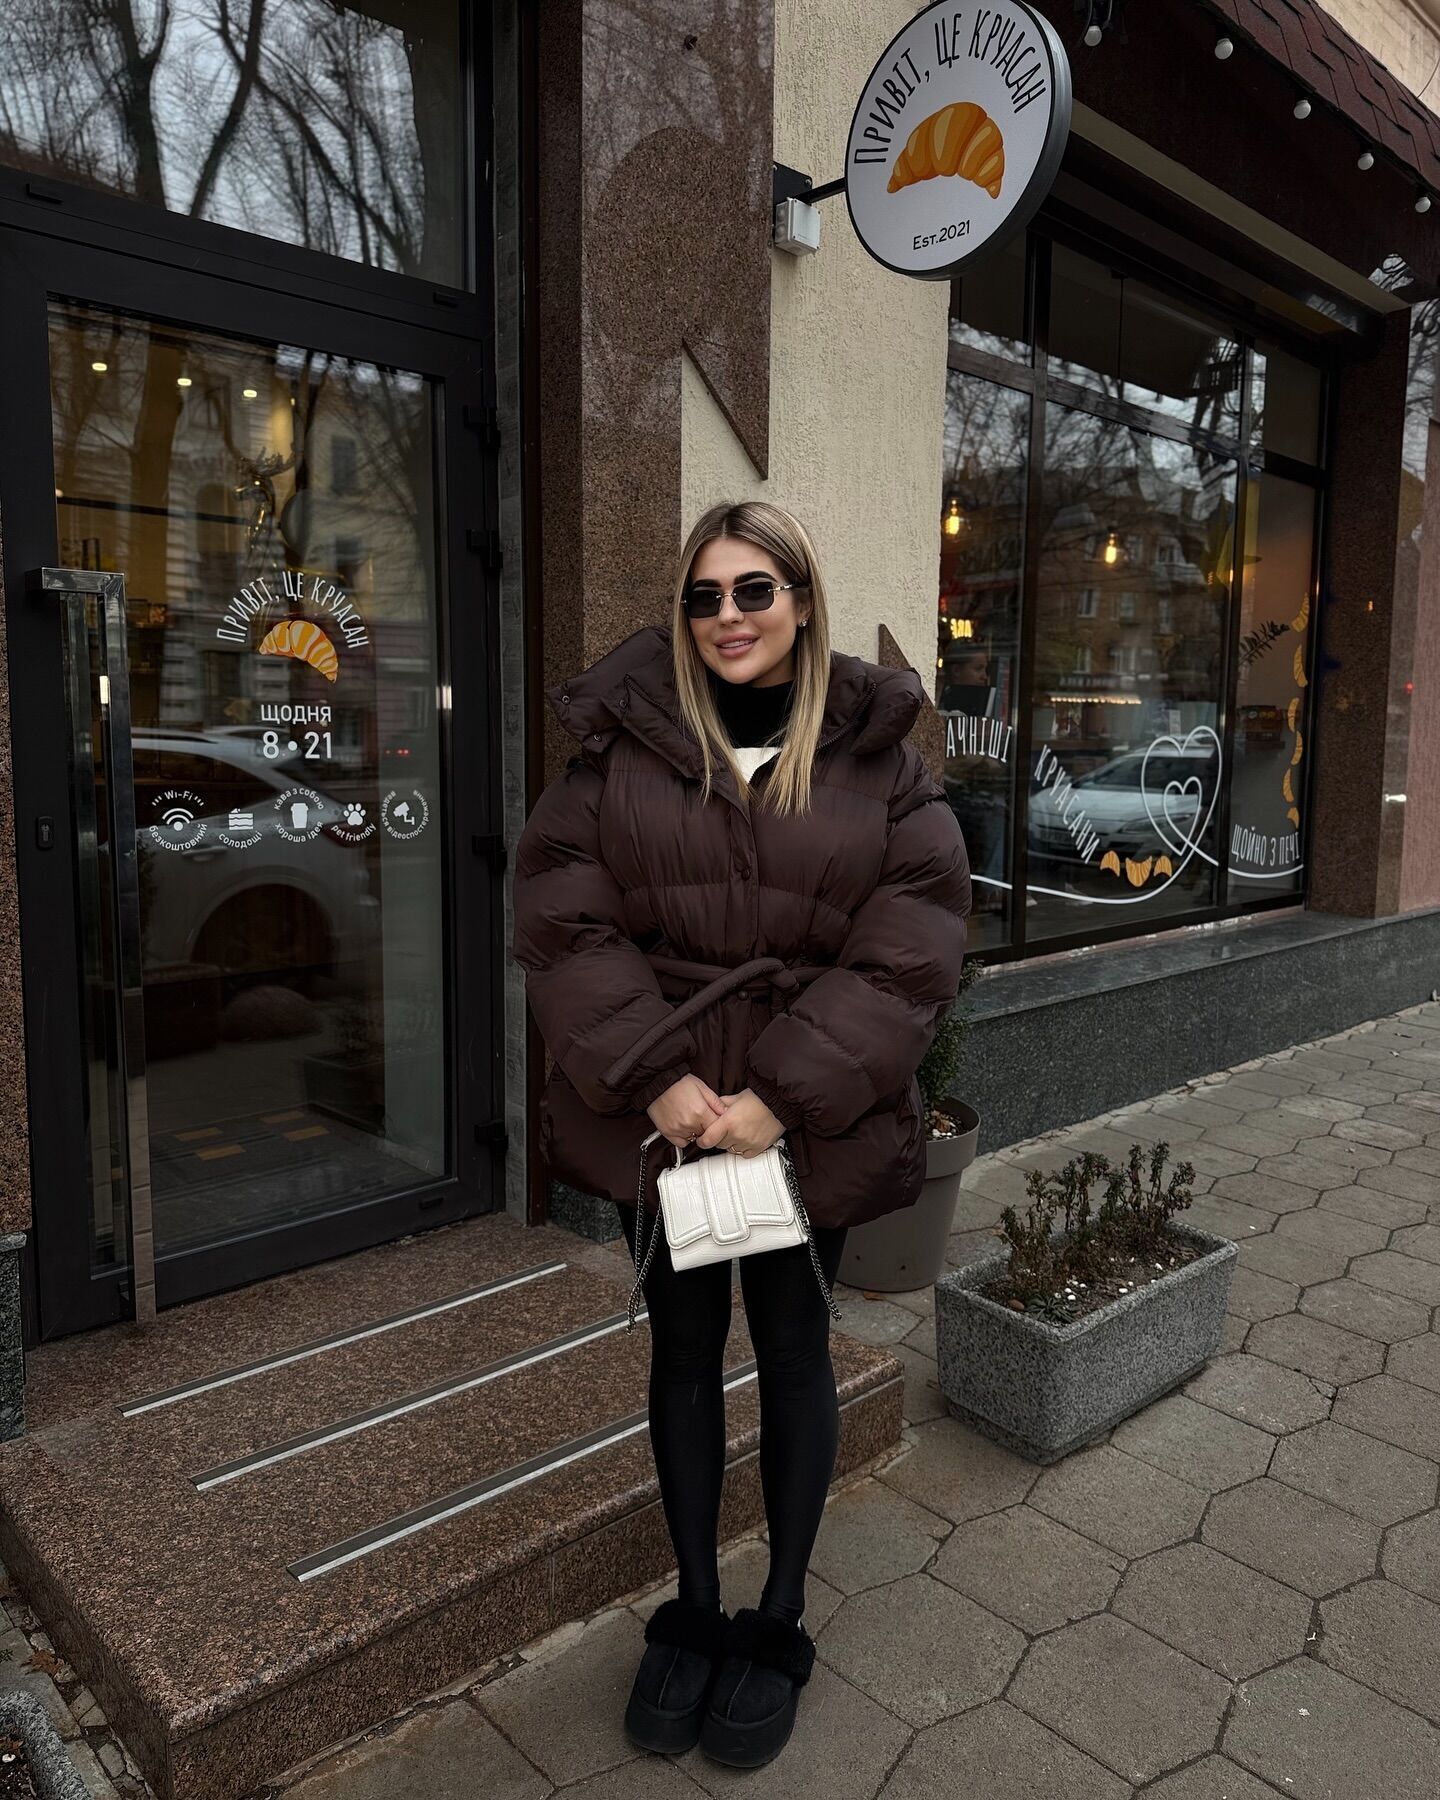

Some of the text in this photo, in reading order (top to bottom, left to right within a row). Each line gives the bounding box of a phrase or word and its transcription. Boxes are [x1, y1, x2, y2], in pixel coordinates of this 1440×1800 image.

[853, 9, 1047, 164] ПРИВІТ, ЦЕ КРУАСАН
[216, 570, 369, 649] ПРИВІТ, ЦЕ КРУАСАН
[299, 787, 324, 810] собою
[1034, 744, 1100, 865] КРУАСАНИ
[149, 823, 208, 851] безкоштовний
[218, 831, 263, 849] солодощі
[275, 821, 324, 843] хороша ідея
[331, 822, 377, 841] pet friendly
[1231, 823, 1300, 867] ЩОЙНО З ПЕЧІ
